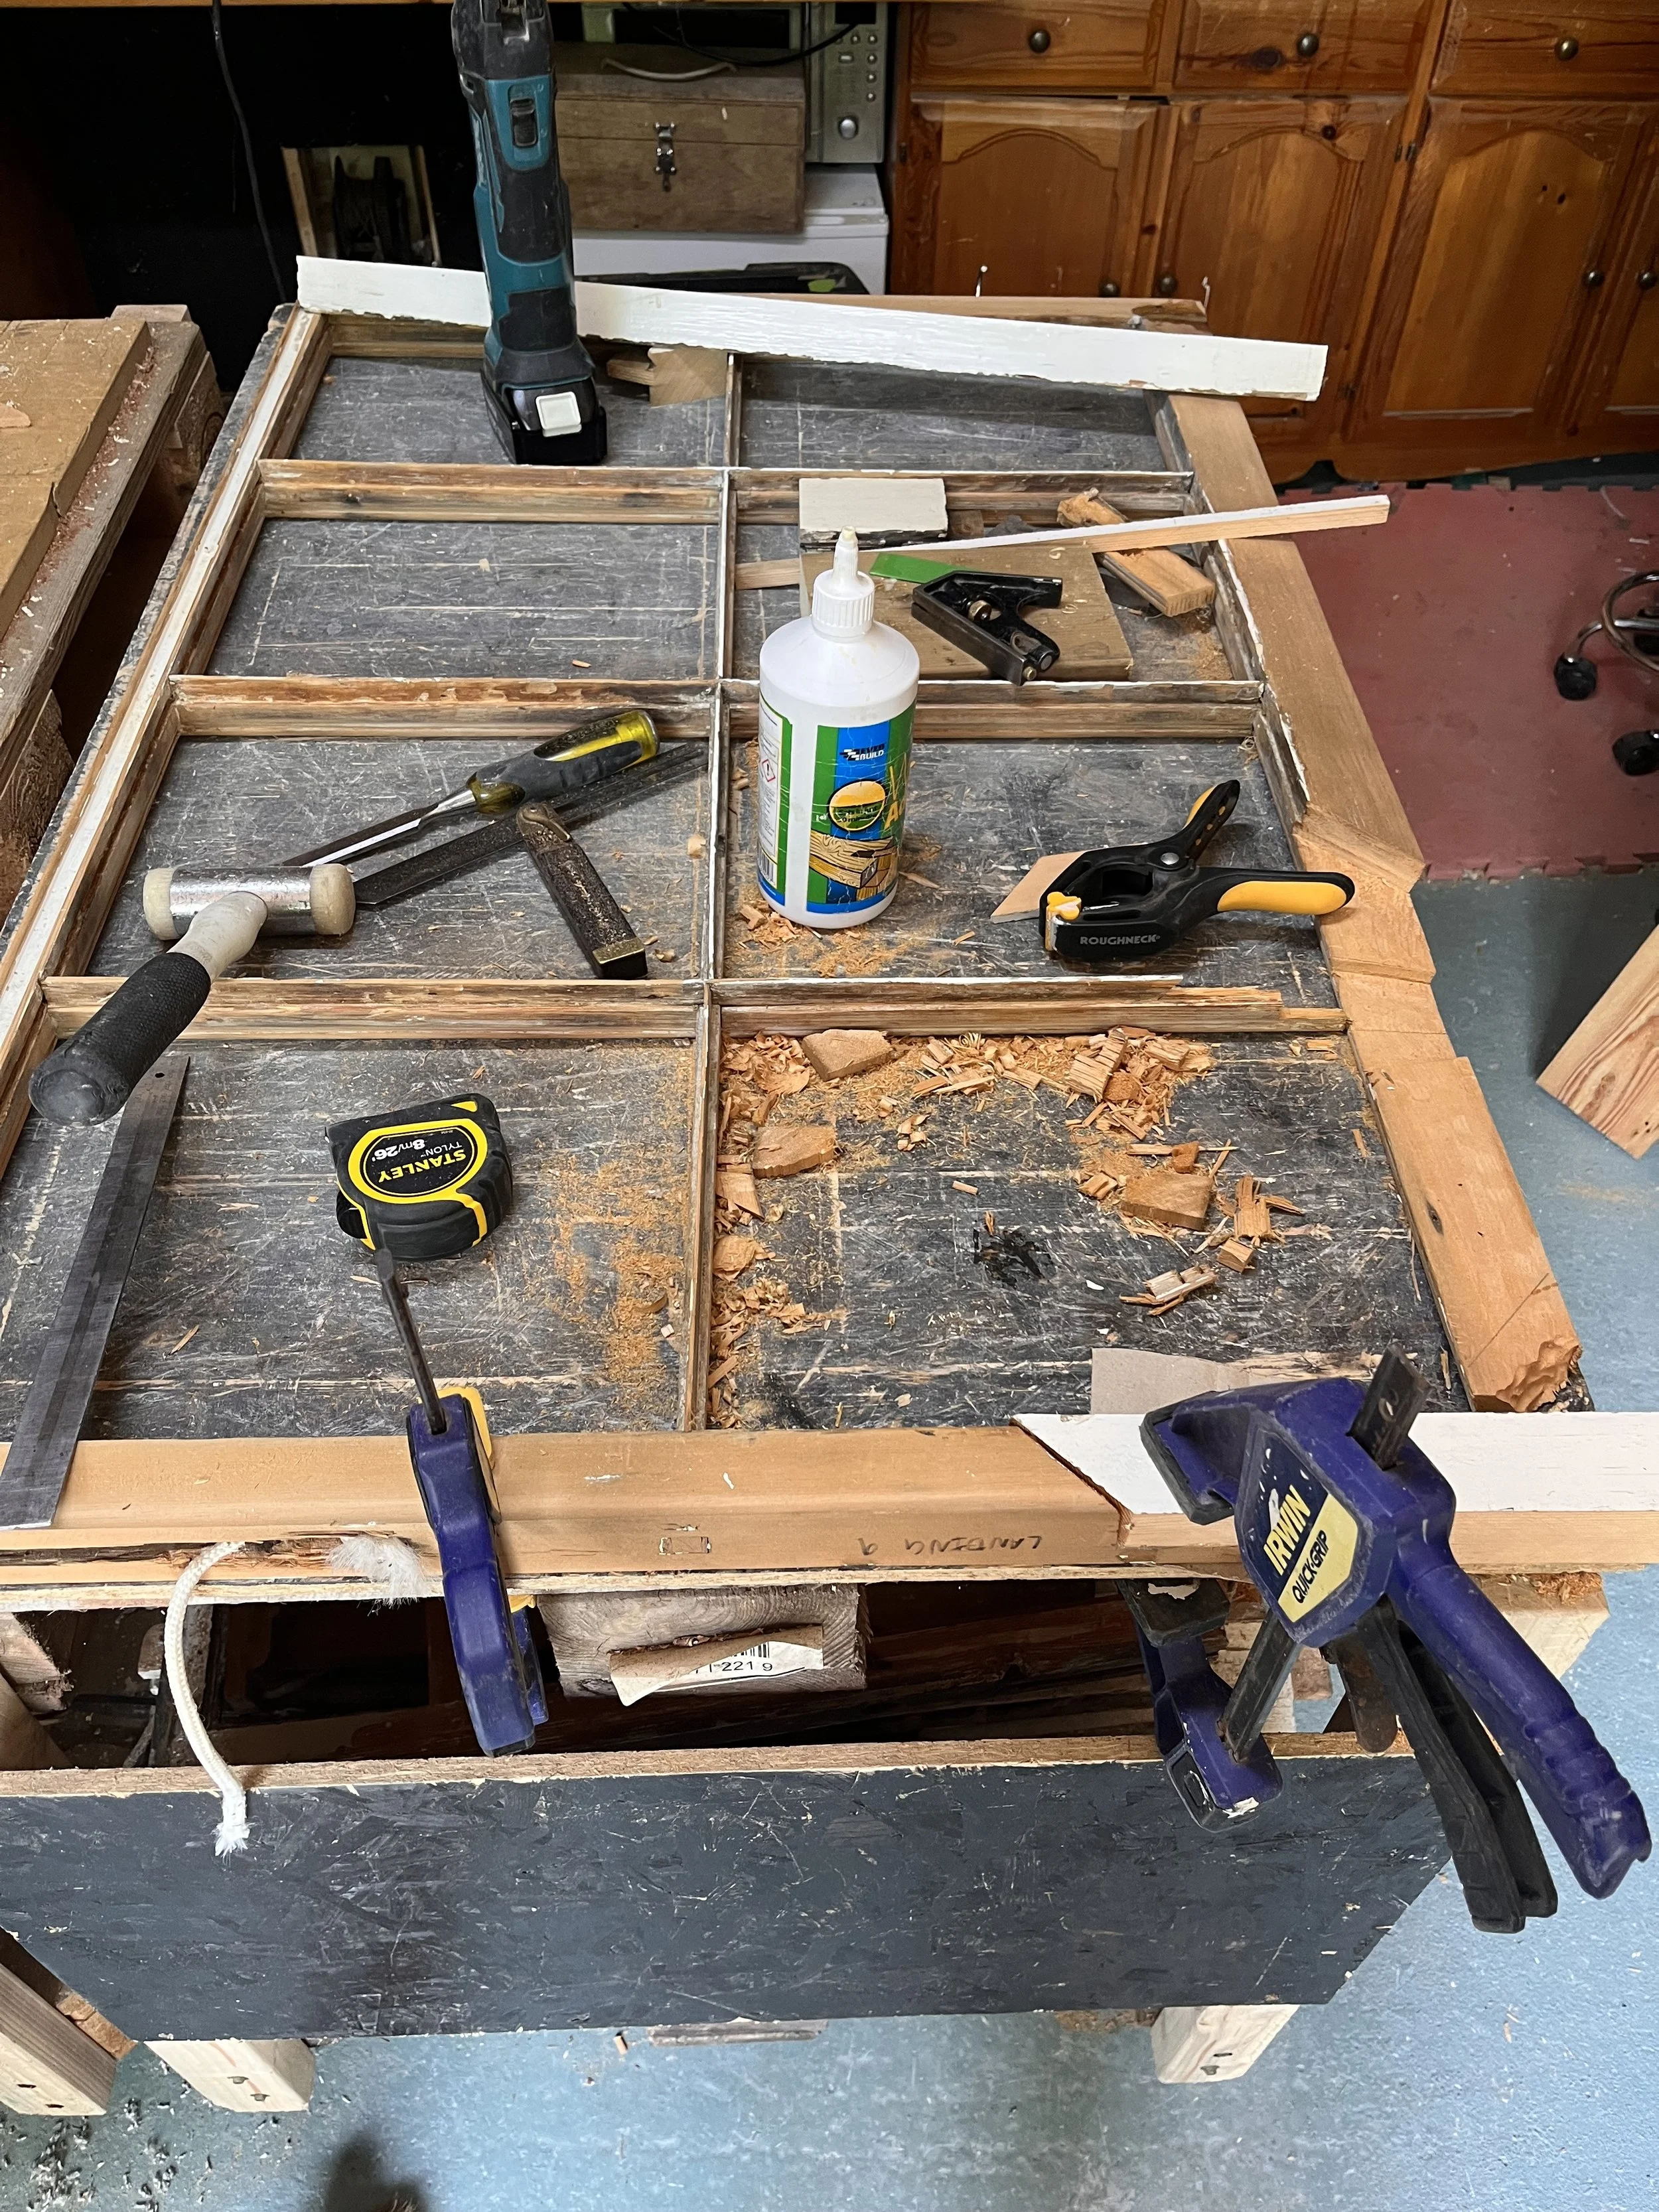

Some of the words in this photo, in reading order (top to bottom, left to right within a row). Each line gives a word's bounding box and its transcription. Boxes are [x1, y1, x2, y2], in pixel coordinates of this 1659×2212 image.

[860, 750, 885, 761] BUILD
[378, 1149, 466, 1183] STANLEY
[1263, 1484, 1311, 1576] IRWIN
[904, 1536, 1043, 1555] LANDING
